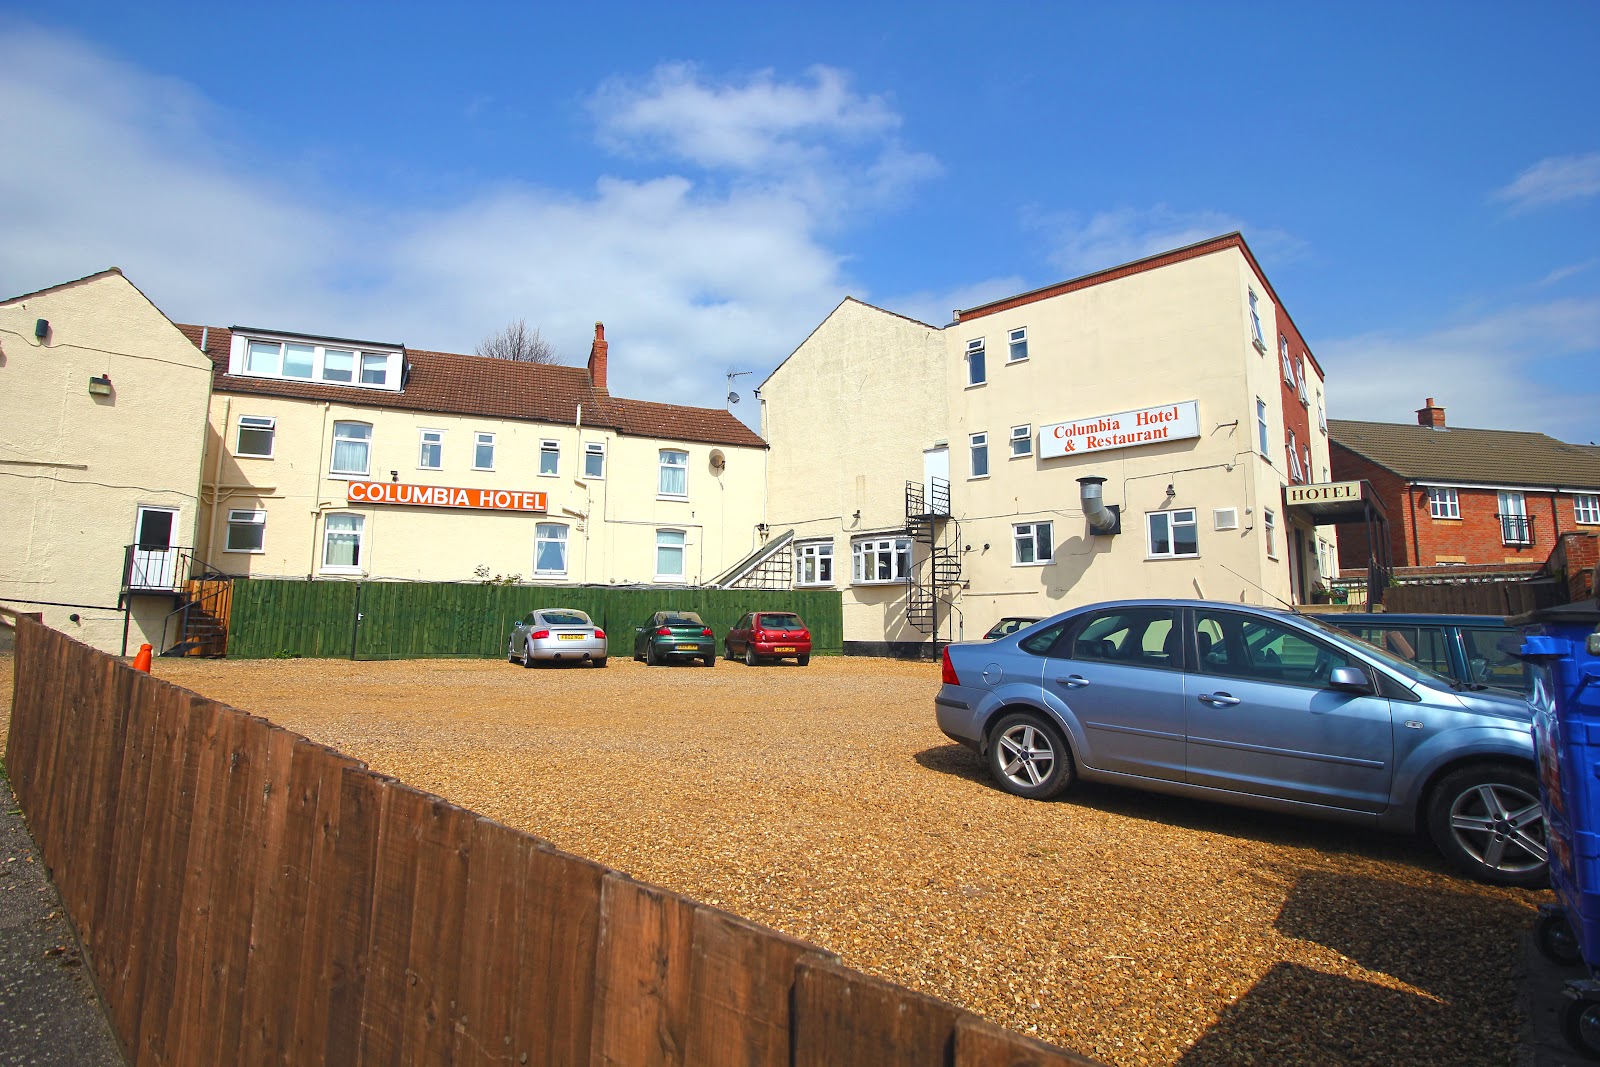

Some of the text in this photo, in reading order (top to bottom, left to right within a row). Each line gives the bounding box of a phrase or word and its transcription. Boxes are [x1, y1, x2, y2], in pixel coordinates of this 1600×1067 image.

[1053, 406, 1179, 439] Columbia Hotel
[1064, 425, 1168, 452] & Restaurant
[348, 482, 545, 510] COLUMBIA HOTEL
[1291, 486, 1357, 501] HOTEL
